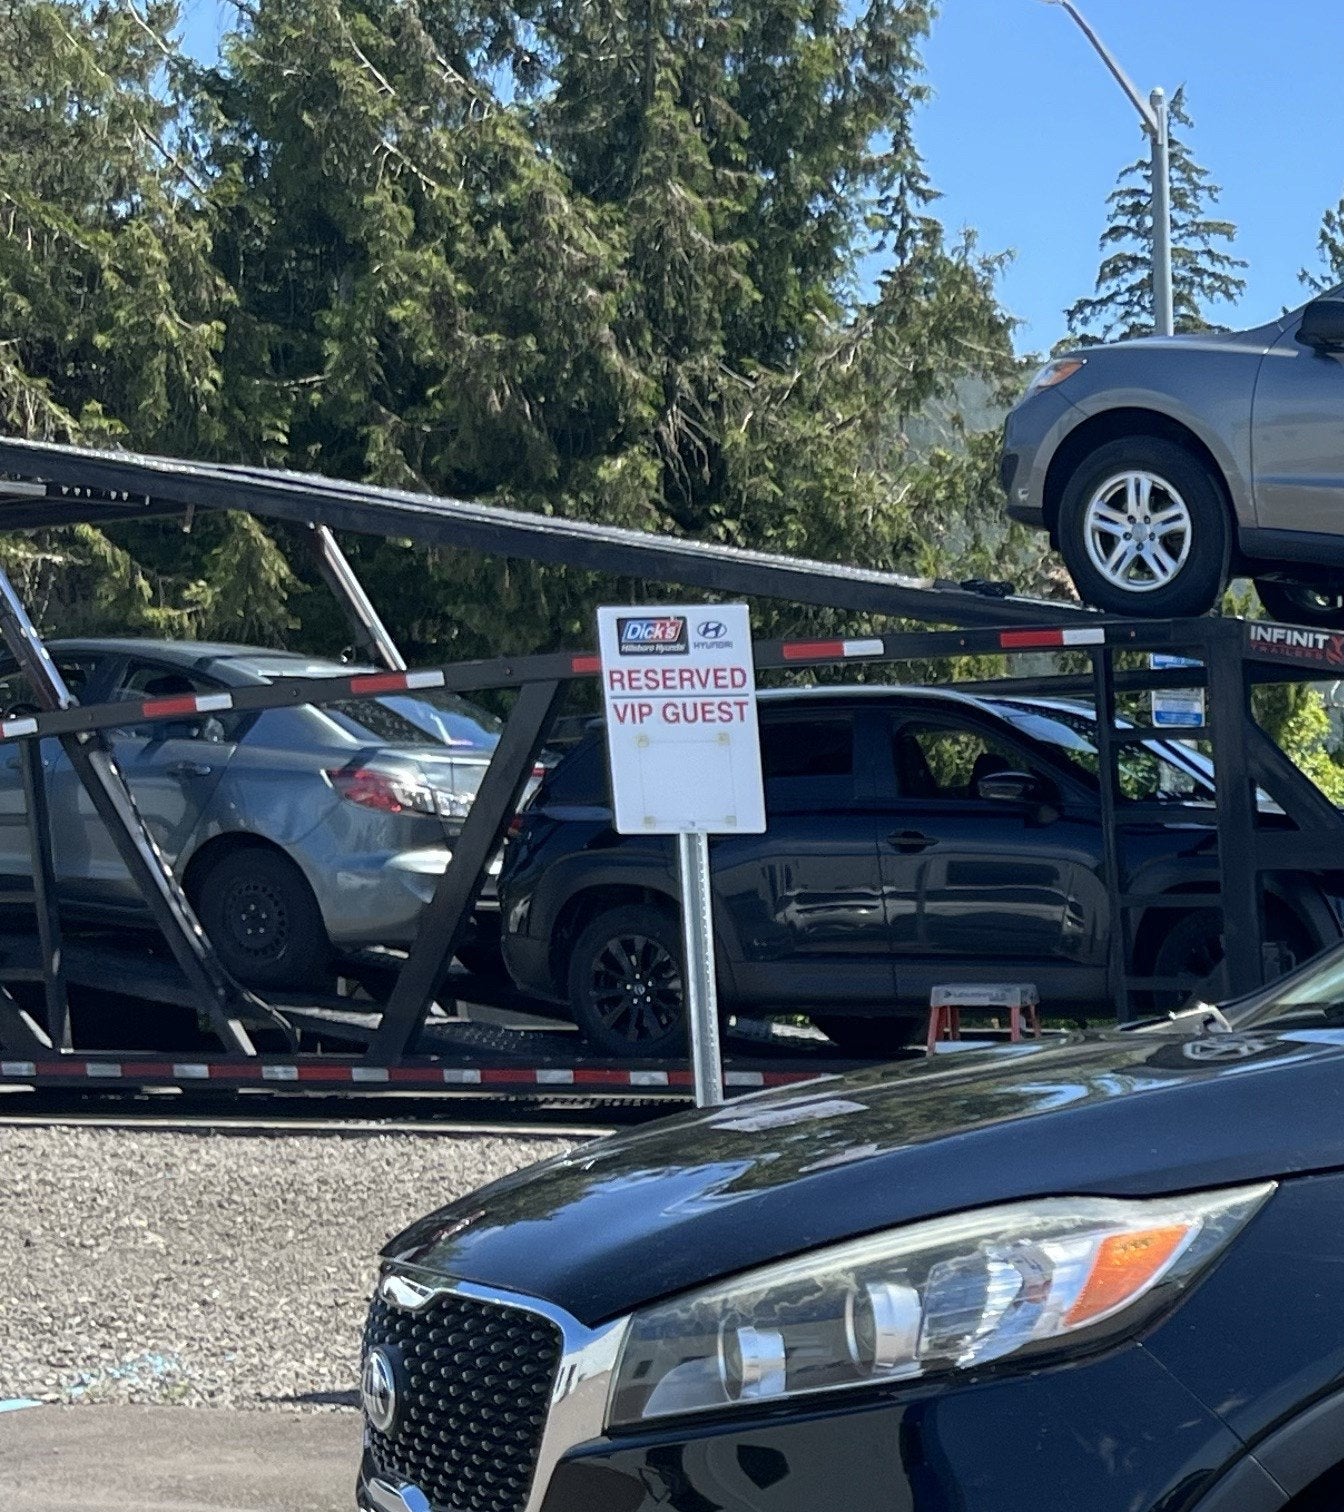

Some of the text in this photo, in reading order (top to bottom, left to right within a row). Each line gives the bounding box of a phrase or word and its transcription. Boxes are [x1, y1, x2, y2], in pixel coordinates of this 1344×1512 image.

[609, 668, 747, 691] RESERVED
[613, 702, 749, 725] VIP GUEST
